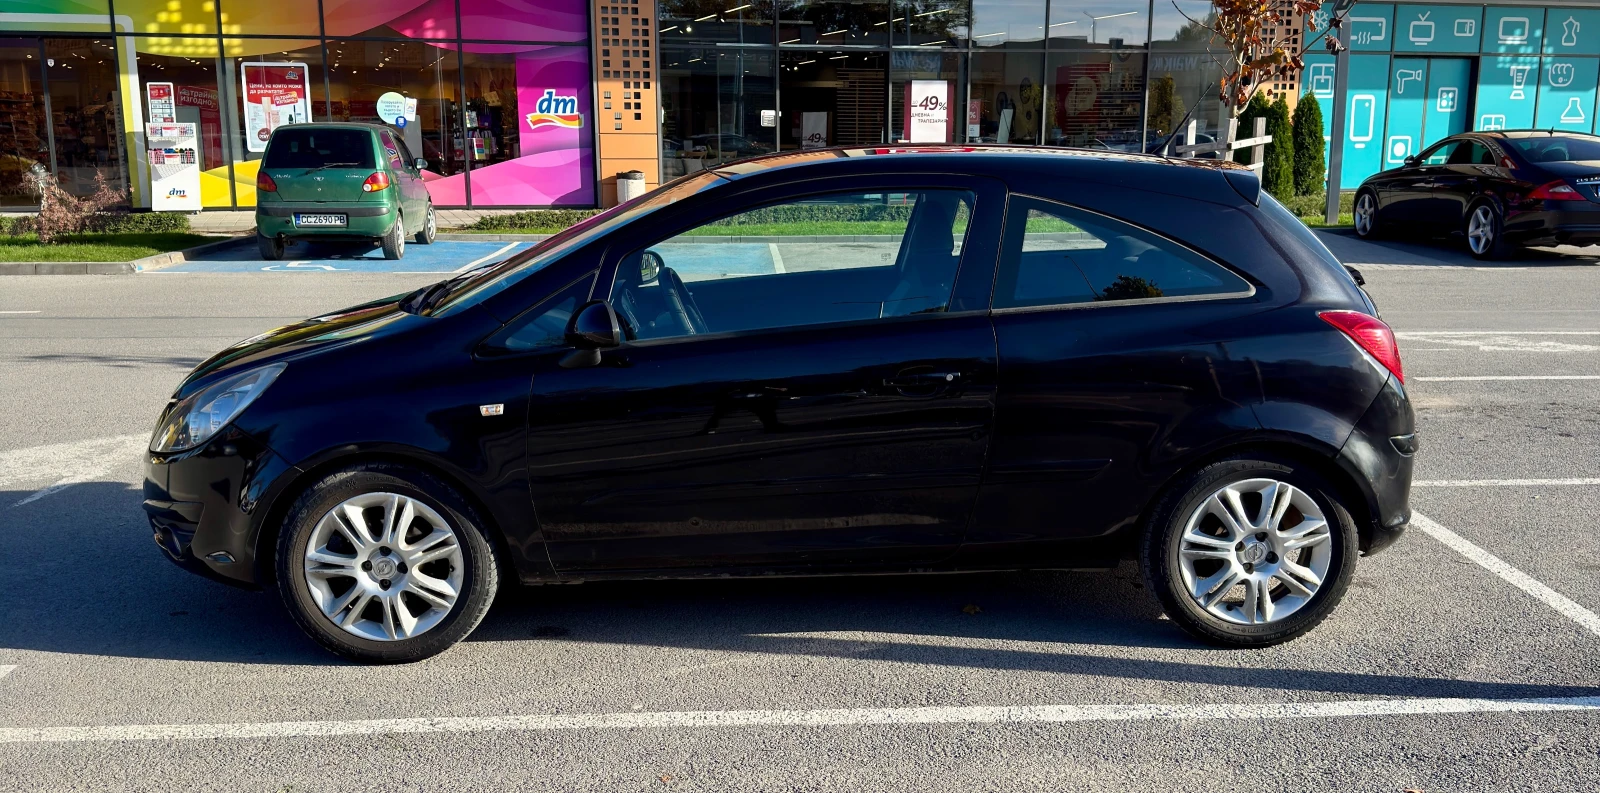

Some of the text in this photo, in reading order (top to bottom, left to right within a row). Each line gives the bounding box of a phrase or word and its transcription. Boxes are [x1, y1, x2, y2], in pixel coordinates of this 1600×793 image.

[190, 90, 218, 100] трайно
[537, 90, 576, 114] dm
[168, 187, 186, 196] dm
[313, 215, 333, 224] 2690
